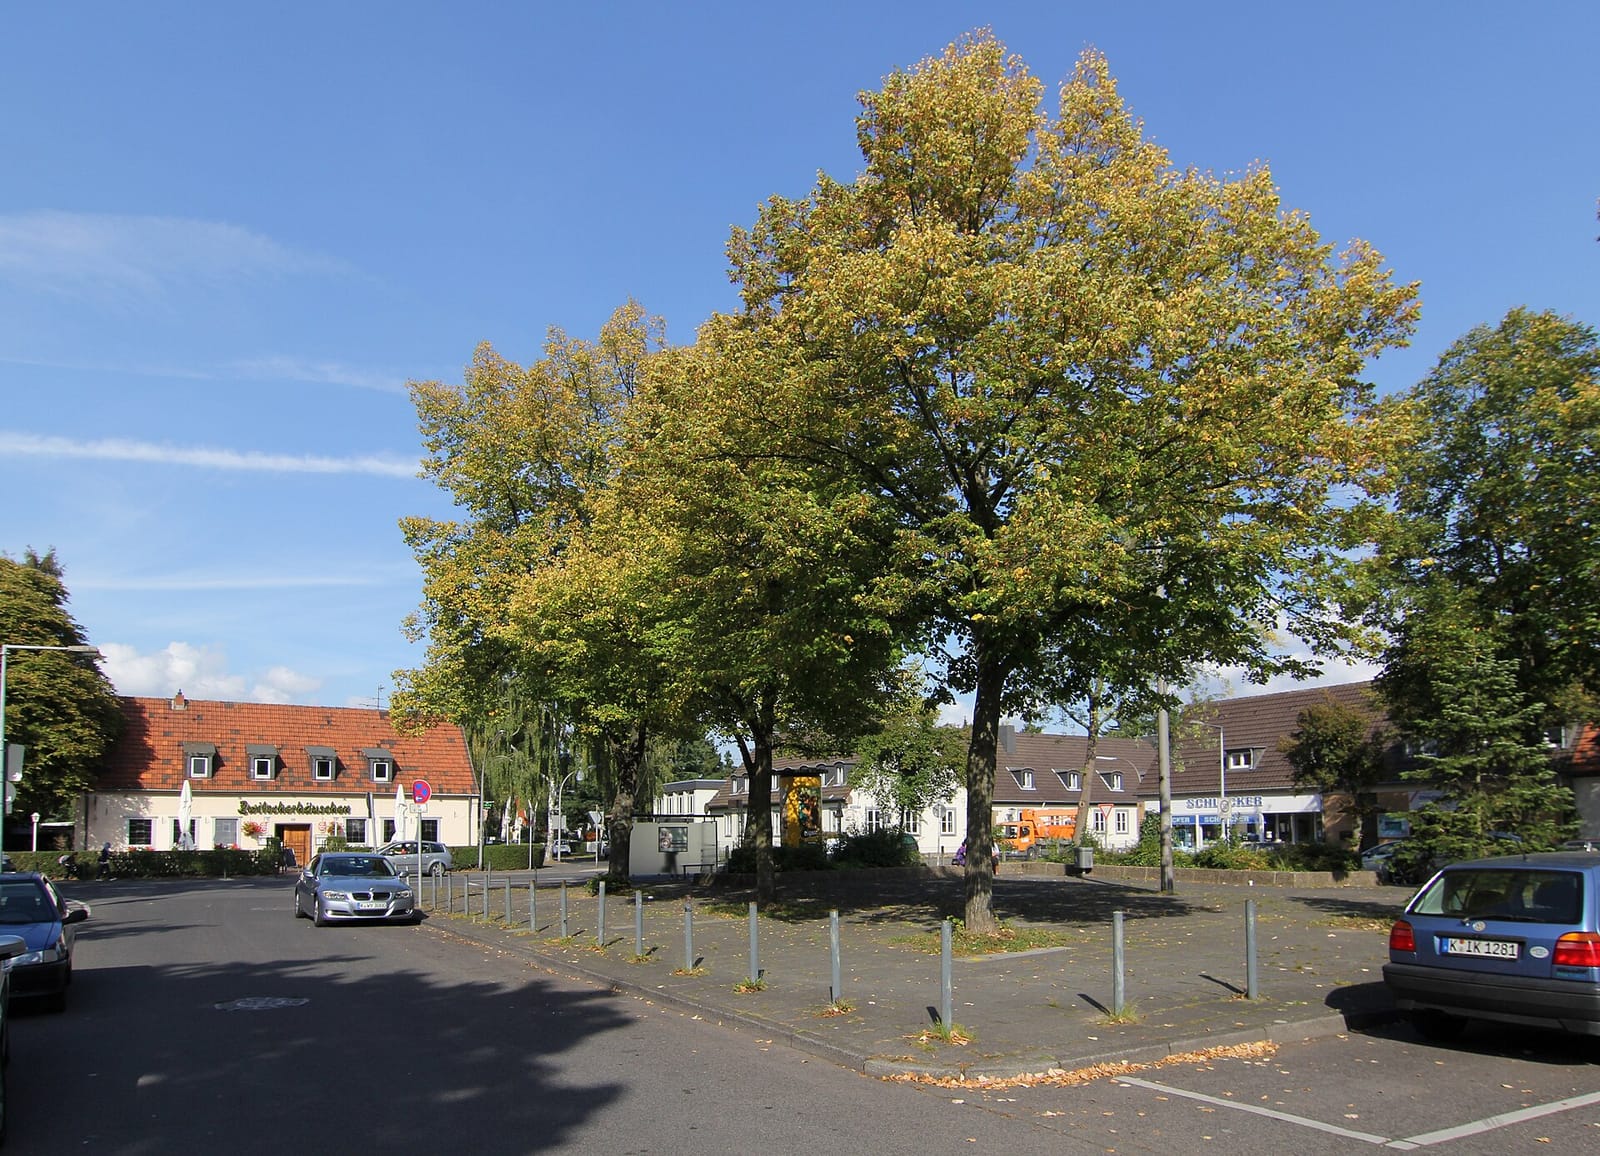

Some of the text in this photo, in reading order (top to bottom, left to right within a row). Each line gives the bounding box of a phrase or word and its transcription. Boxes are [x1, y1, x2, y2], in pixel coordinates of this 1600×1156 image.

[1186, 796, 1262, 809] SCHLCKER
[1450, 940, 1457, 952] K
[1466, 940, 1481, 953] IK
[1484, 942, 1516, 956] 1281
